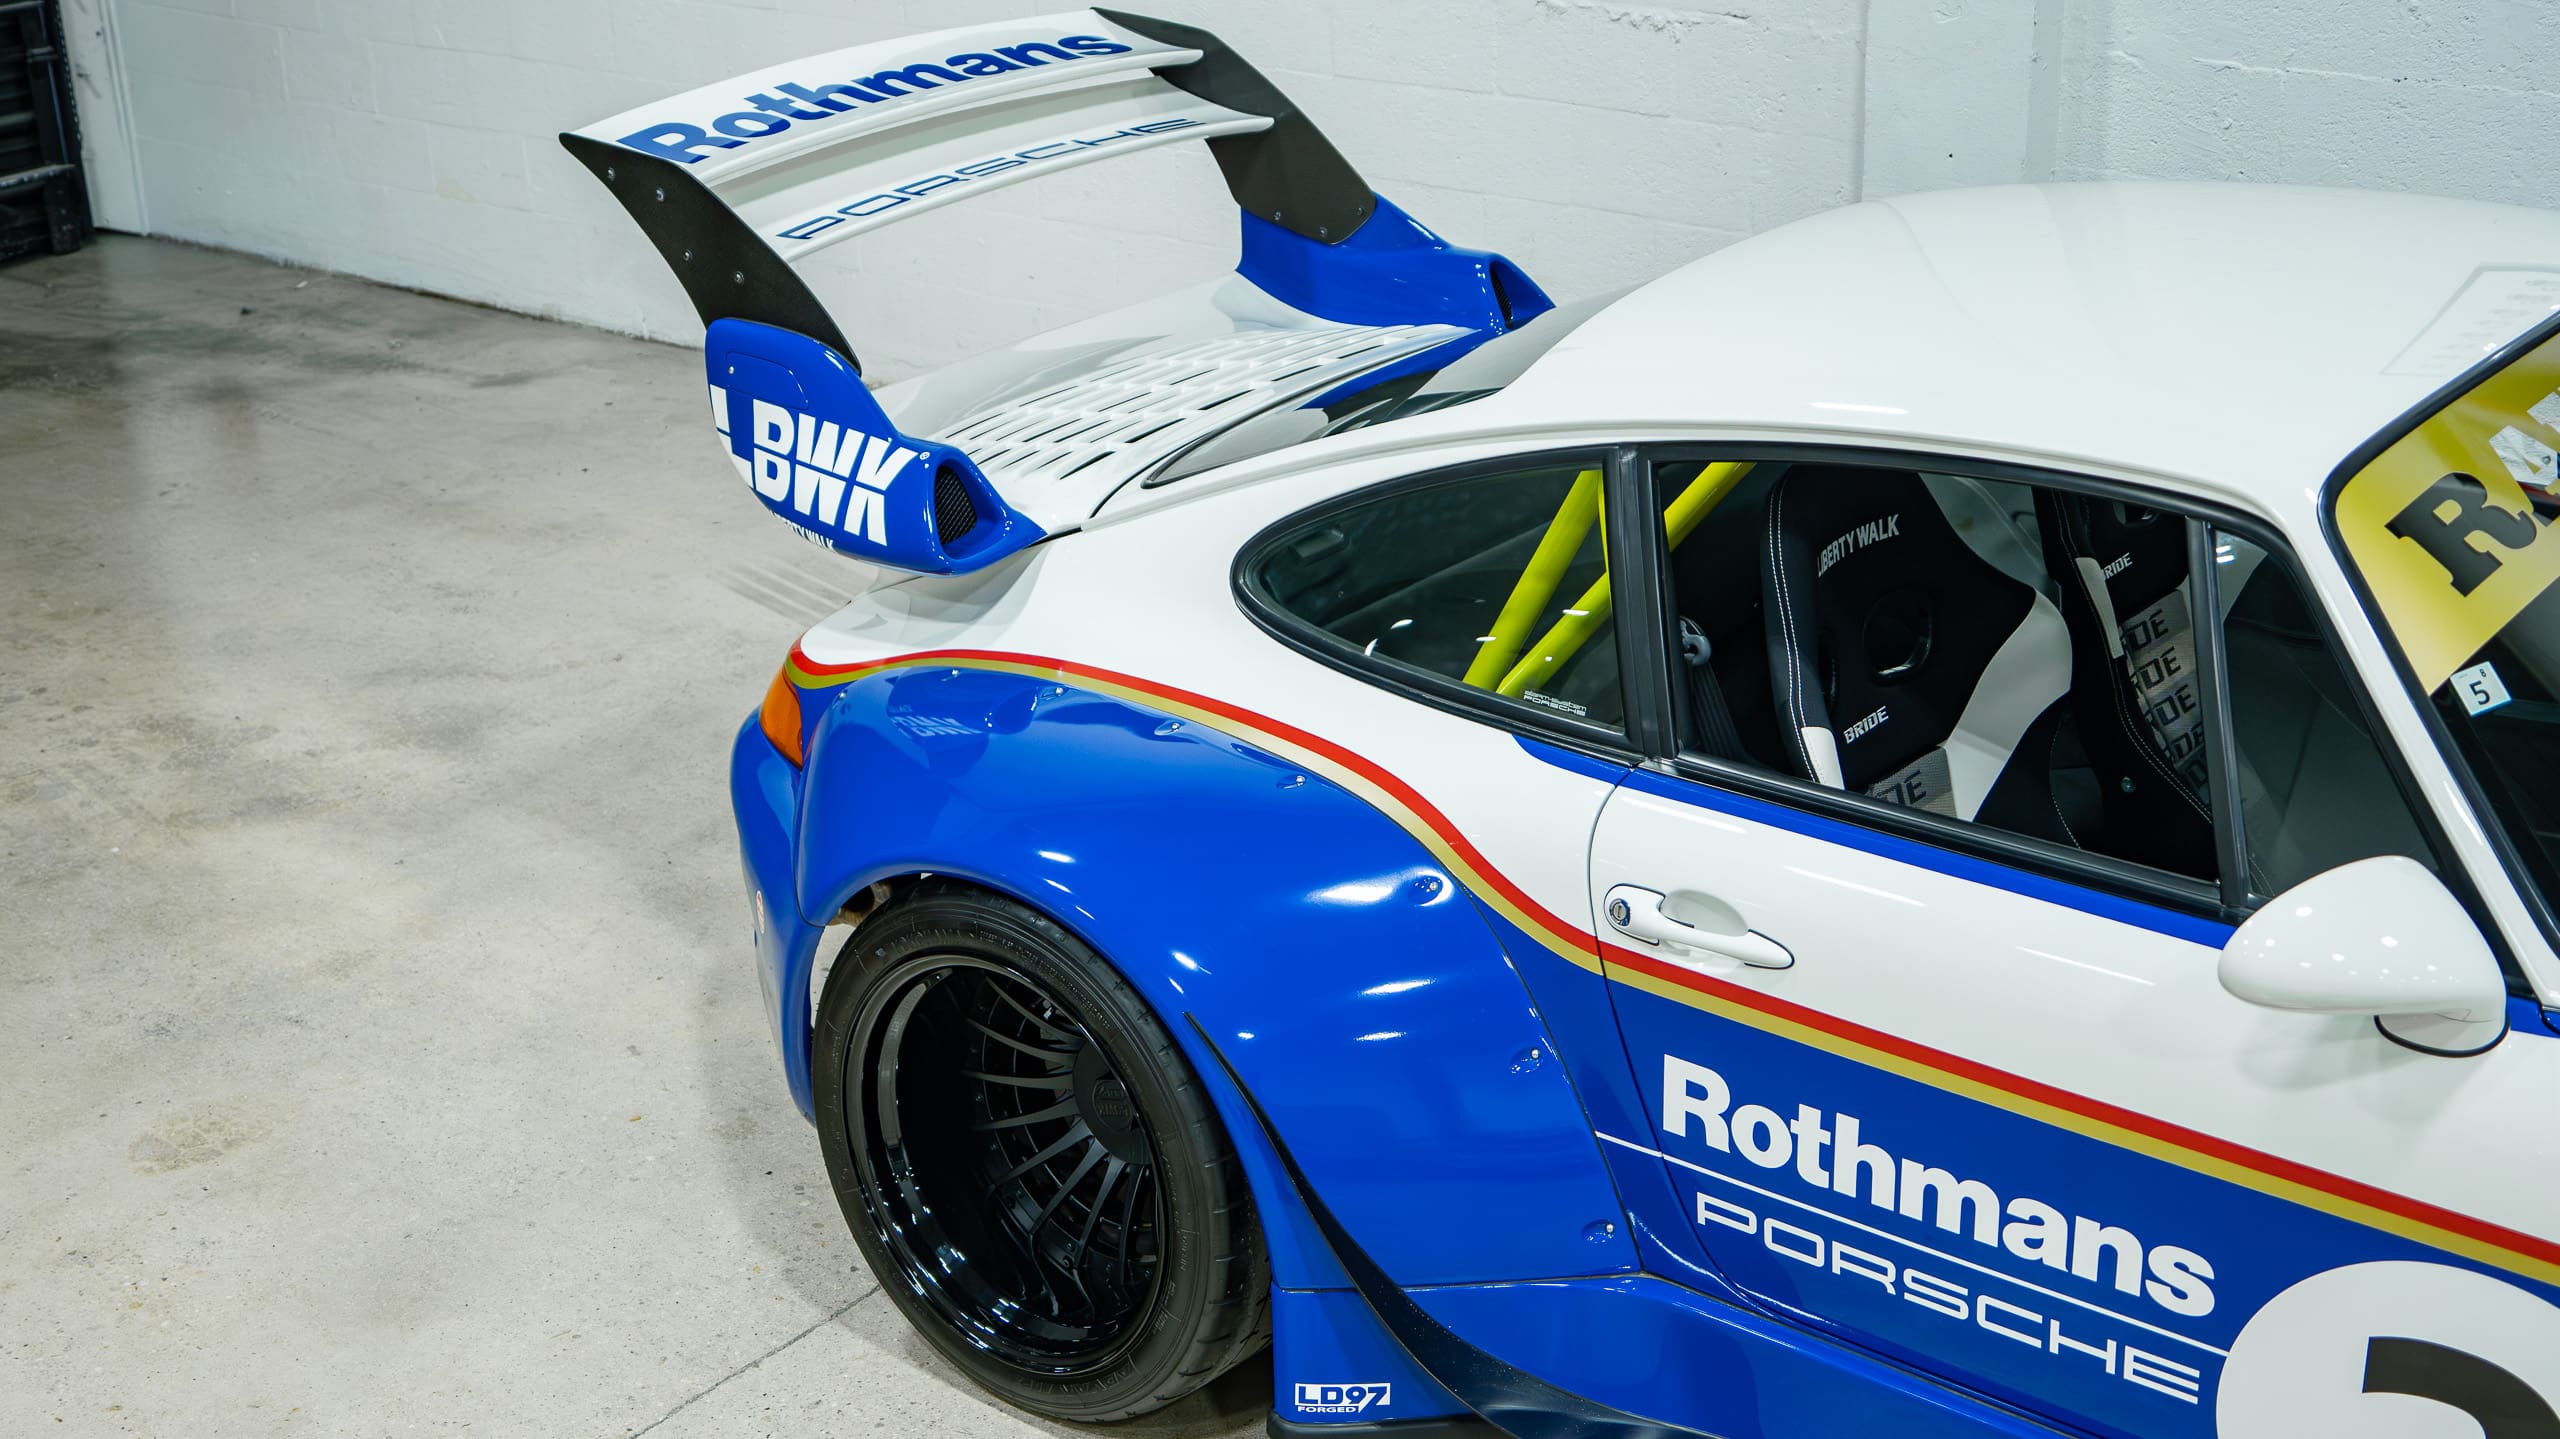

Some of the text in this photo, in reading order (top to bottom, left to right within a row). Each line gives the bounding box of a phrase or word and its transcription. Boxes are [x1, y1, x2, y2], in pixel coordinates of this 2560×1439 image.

[616, 32, 1133, 164] Rothmans
[777, 117, 1201, 240] PORSCHE
[1816, 513, 1900, 578] LIBERTY WALK
[2103, 552, 2133, 579] RIDE
[1523, 694, 1587, 717] PORSCHE
[2468, 679, 2490, 705] 5
[1843, 705, 1889, 744] BRIDE
[1662, 1053, 2216, 1317] Rothmans
[1696, 1191, 2201, 1405] PORSCHE
[1295, 1383, 1391, 1412] LD97
[1297, 1405, 1357, 1413] FORGED
